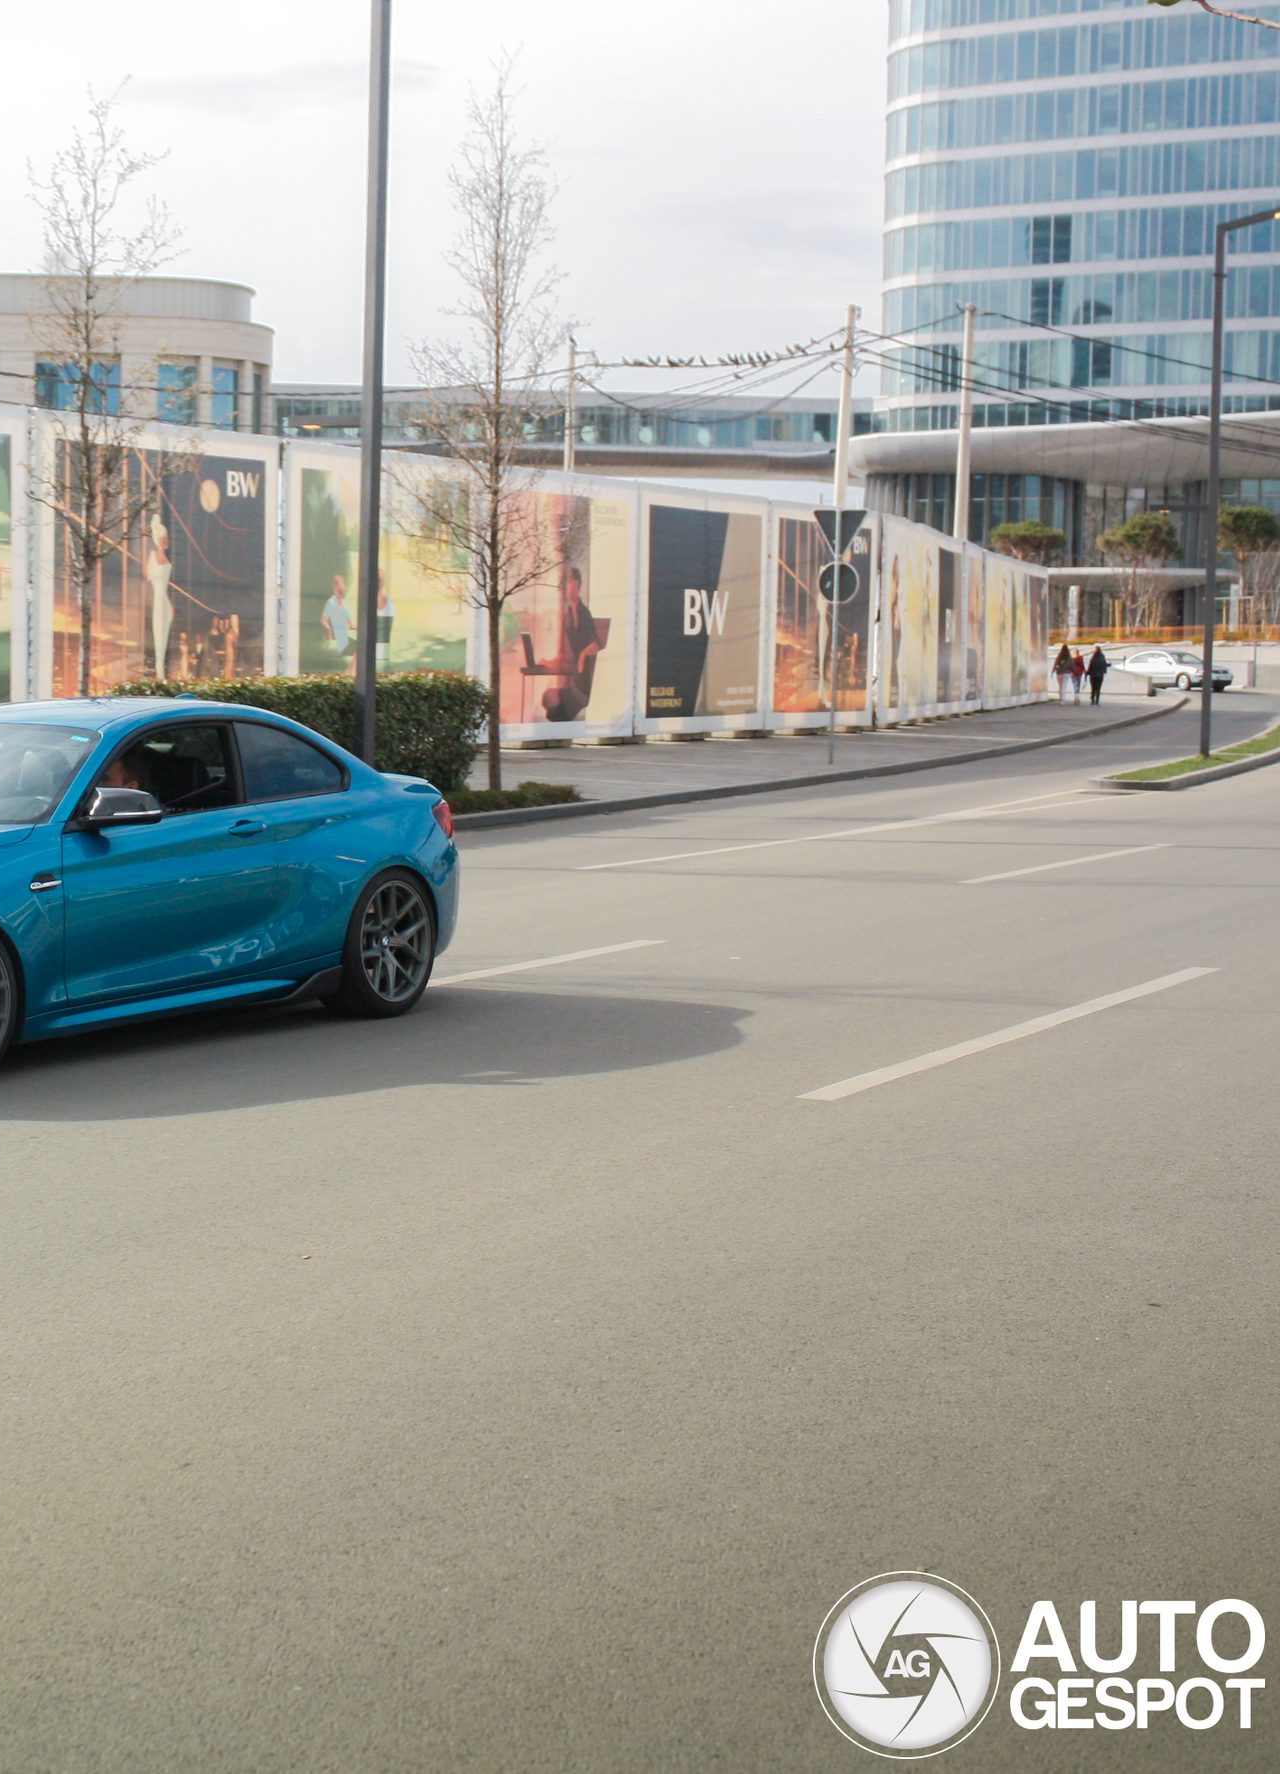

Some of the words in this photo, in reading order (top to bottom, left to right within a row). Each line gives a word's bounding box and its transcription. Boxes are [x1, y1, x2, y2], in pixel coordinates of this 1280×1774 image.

[226, 470, 260, 498] BW
[853, 535, 869, 554] BW
[683, 588, 730, 636] BW
